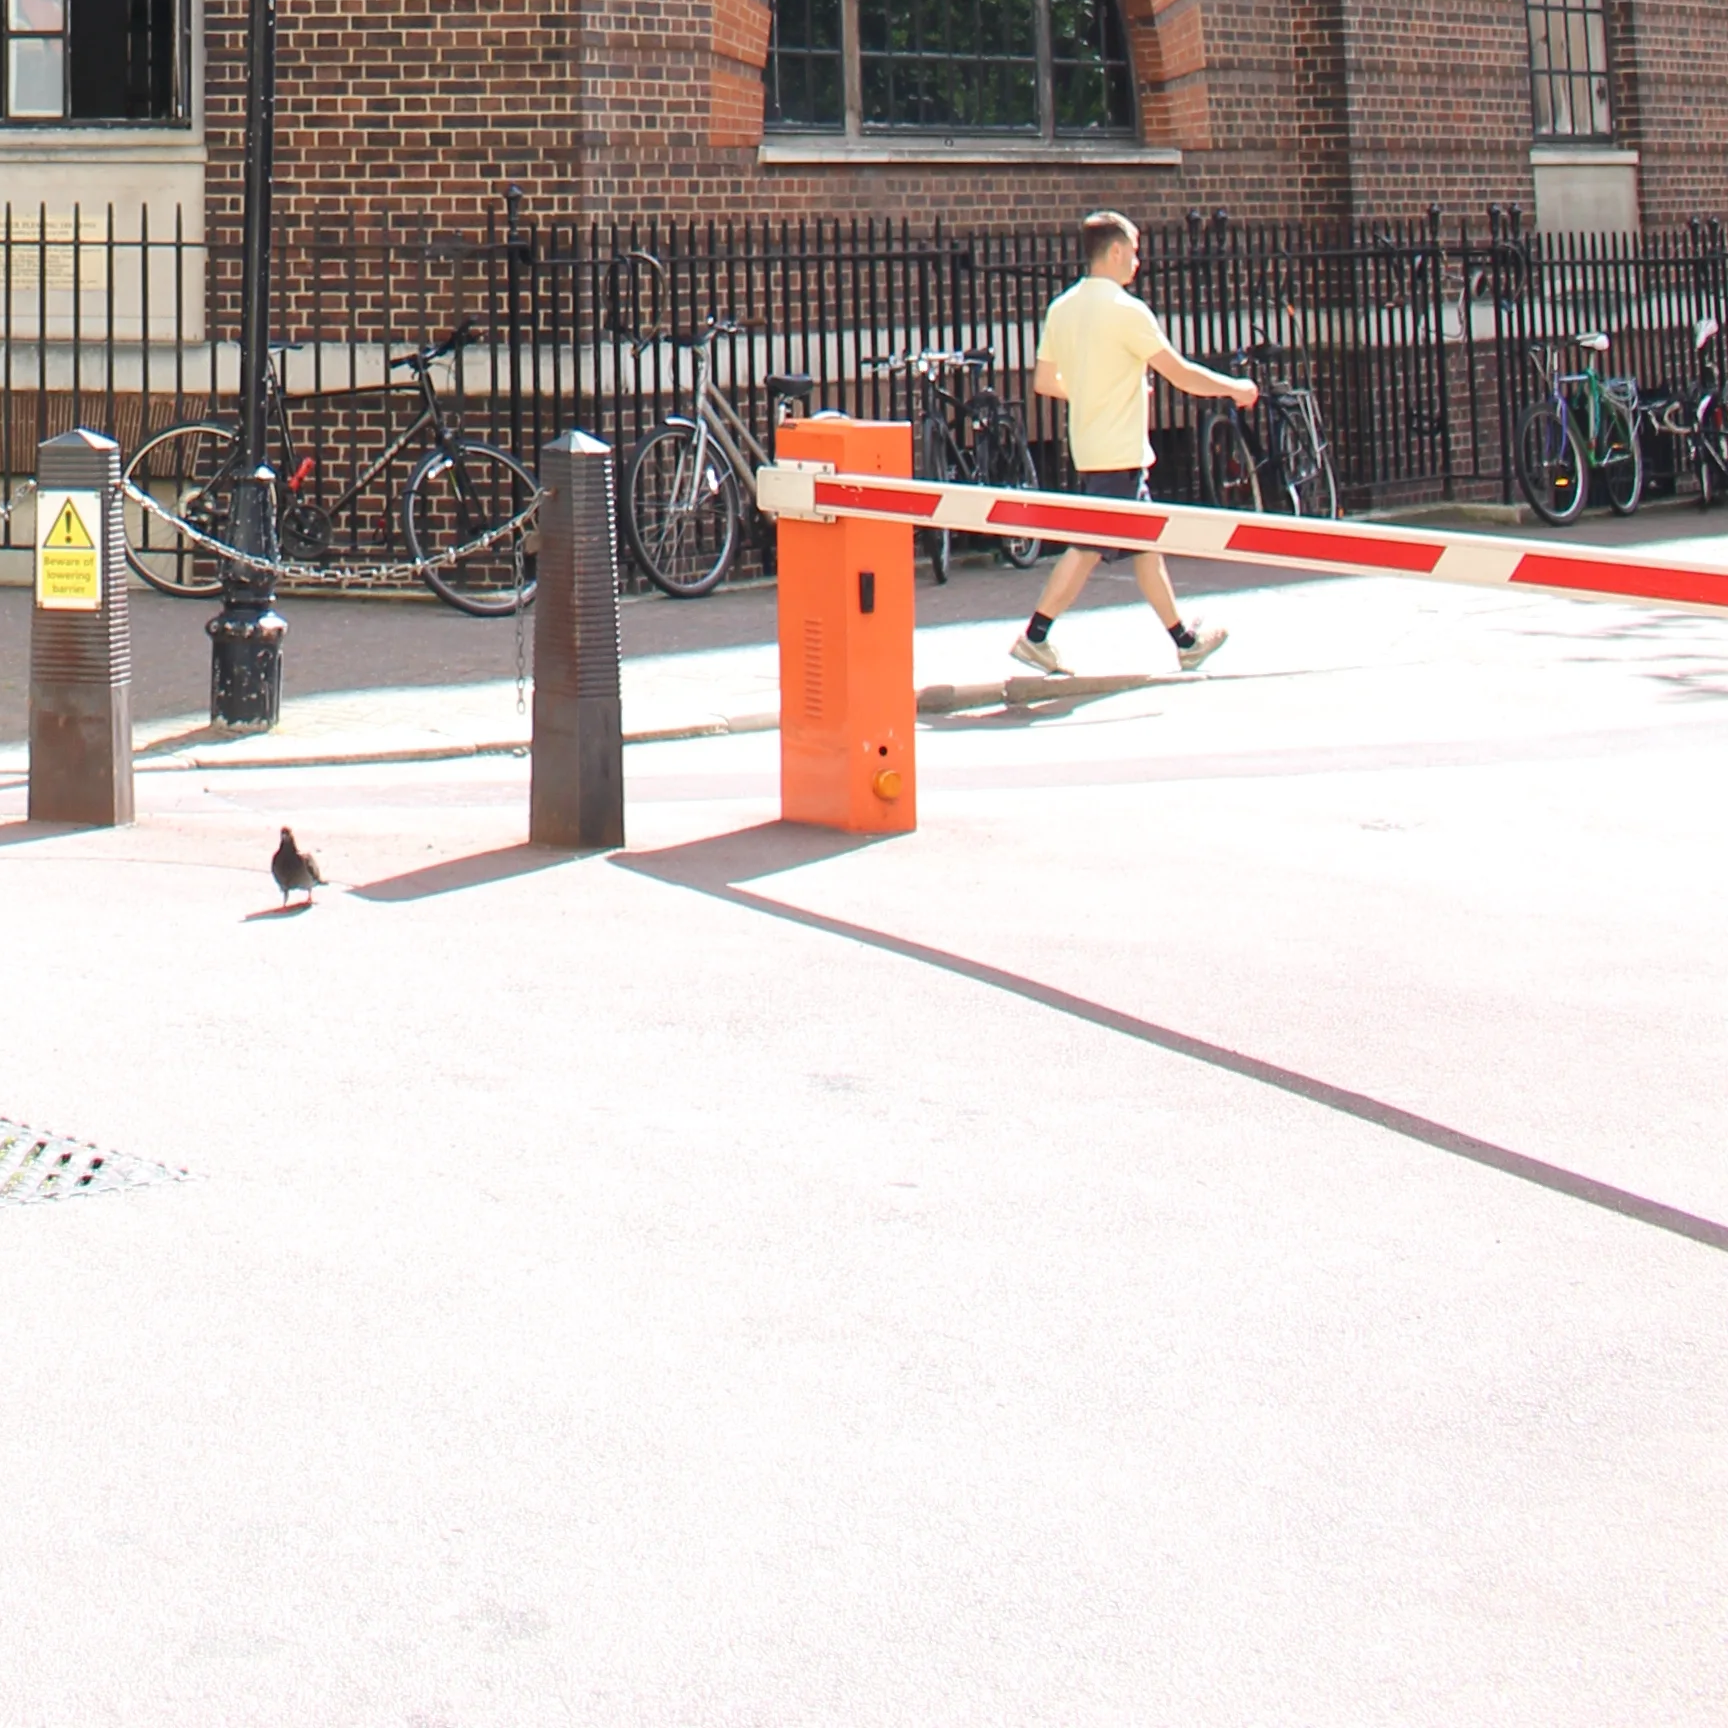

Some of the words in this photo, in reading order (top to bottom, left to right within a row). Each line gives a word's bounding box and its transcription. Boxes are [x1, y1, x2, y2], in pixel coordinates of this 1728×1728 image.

[44, 556, 81, 566] Beware
[83, 556, 95, 566] of
[47, 571, 91, 582] lowering
[52, 585, 86, 594] barrier
